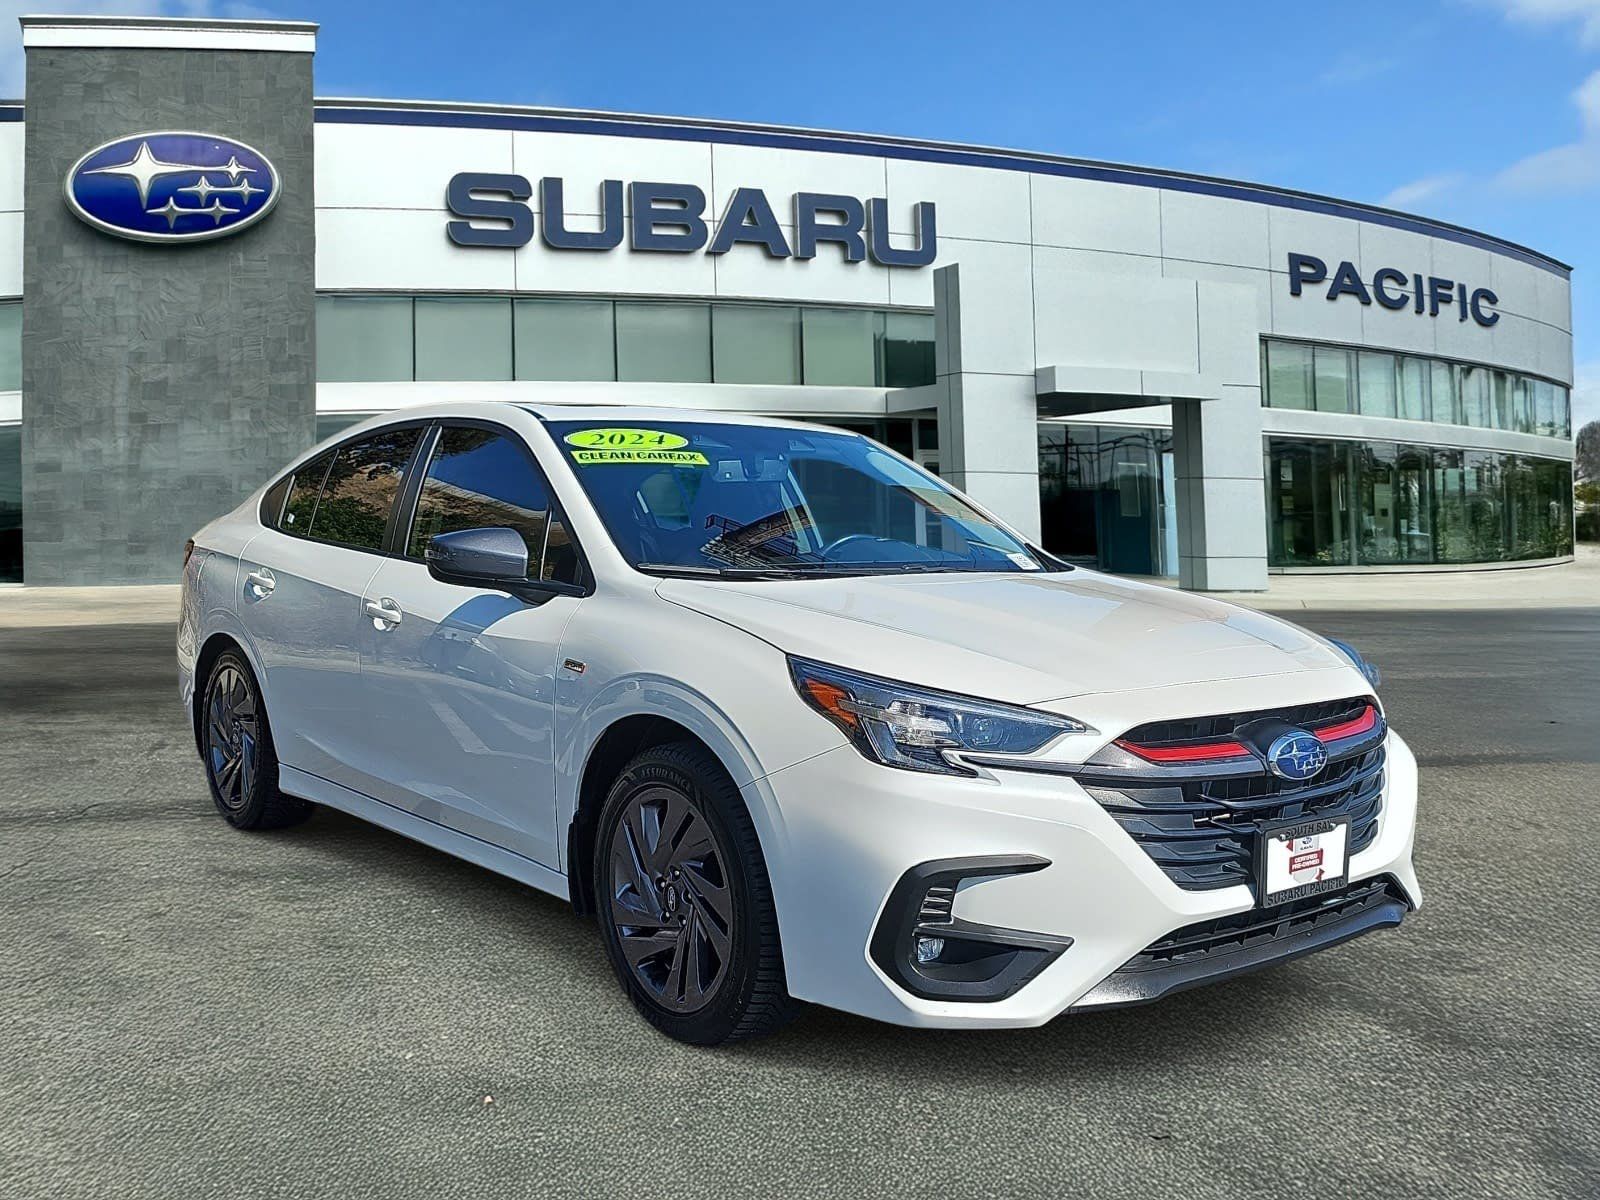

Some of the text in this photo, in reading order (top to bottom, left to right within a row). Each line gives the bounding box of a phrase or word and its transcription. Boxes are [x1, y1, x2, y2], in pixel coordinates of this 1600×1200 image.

[447, 172, 937, 267] SUBARU
[1288, 252, 1500, 327] PACIFIC
[589, 433, 666, 446] 2024
[578, 452, 699, 461] CLEAN CARFAX
[1285, 822, 1314, 839] SOUTH
[1291, 858, 1320, 871] PRE-OWNED
[1267, 877, 1346, 905] SUBARU PACIFIC
